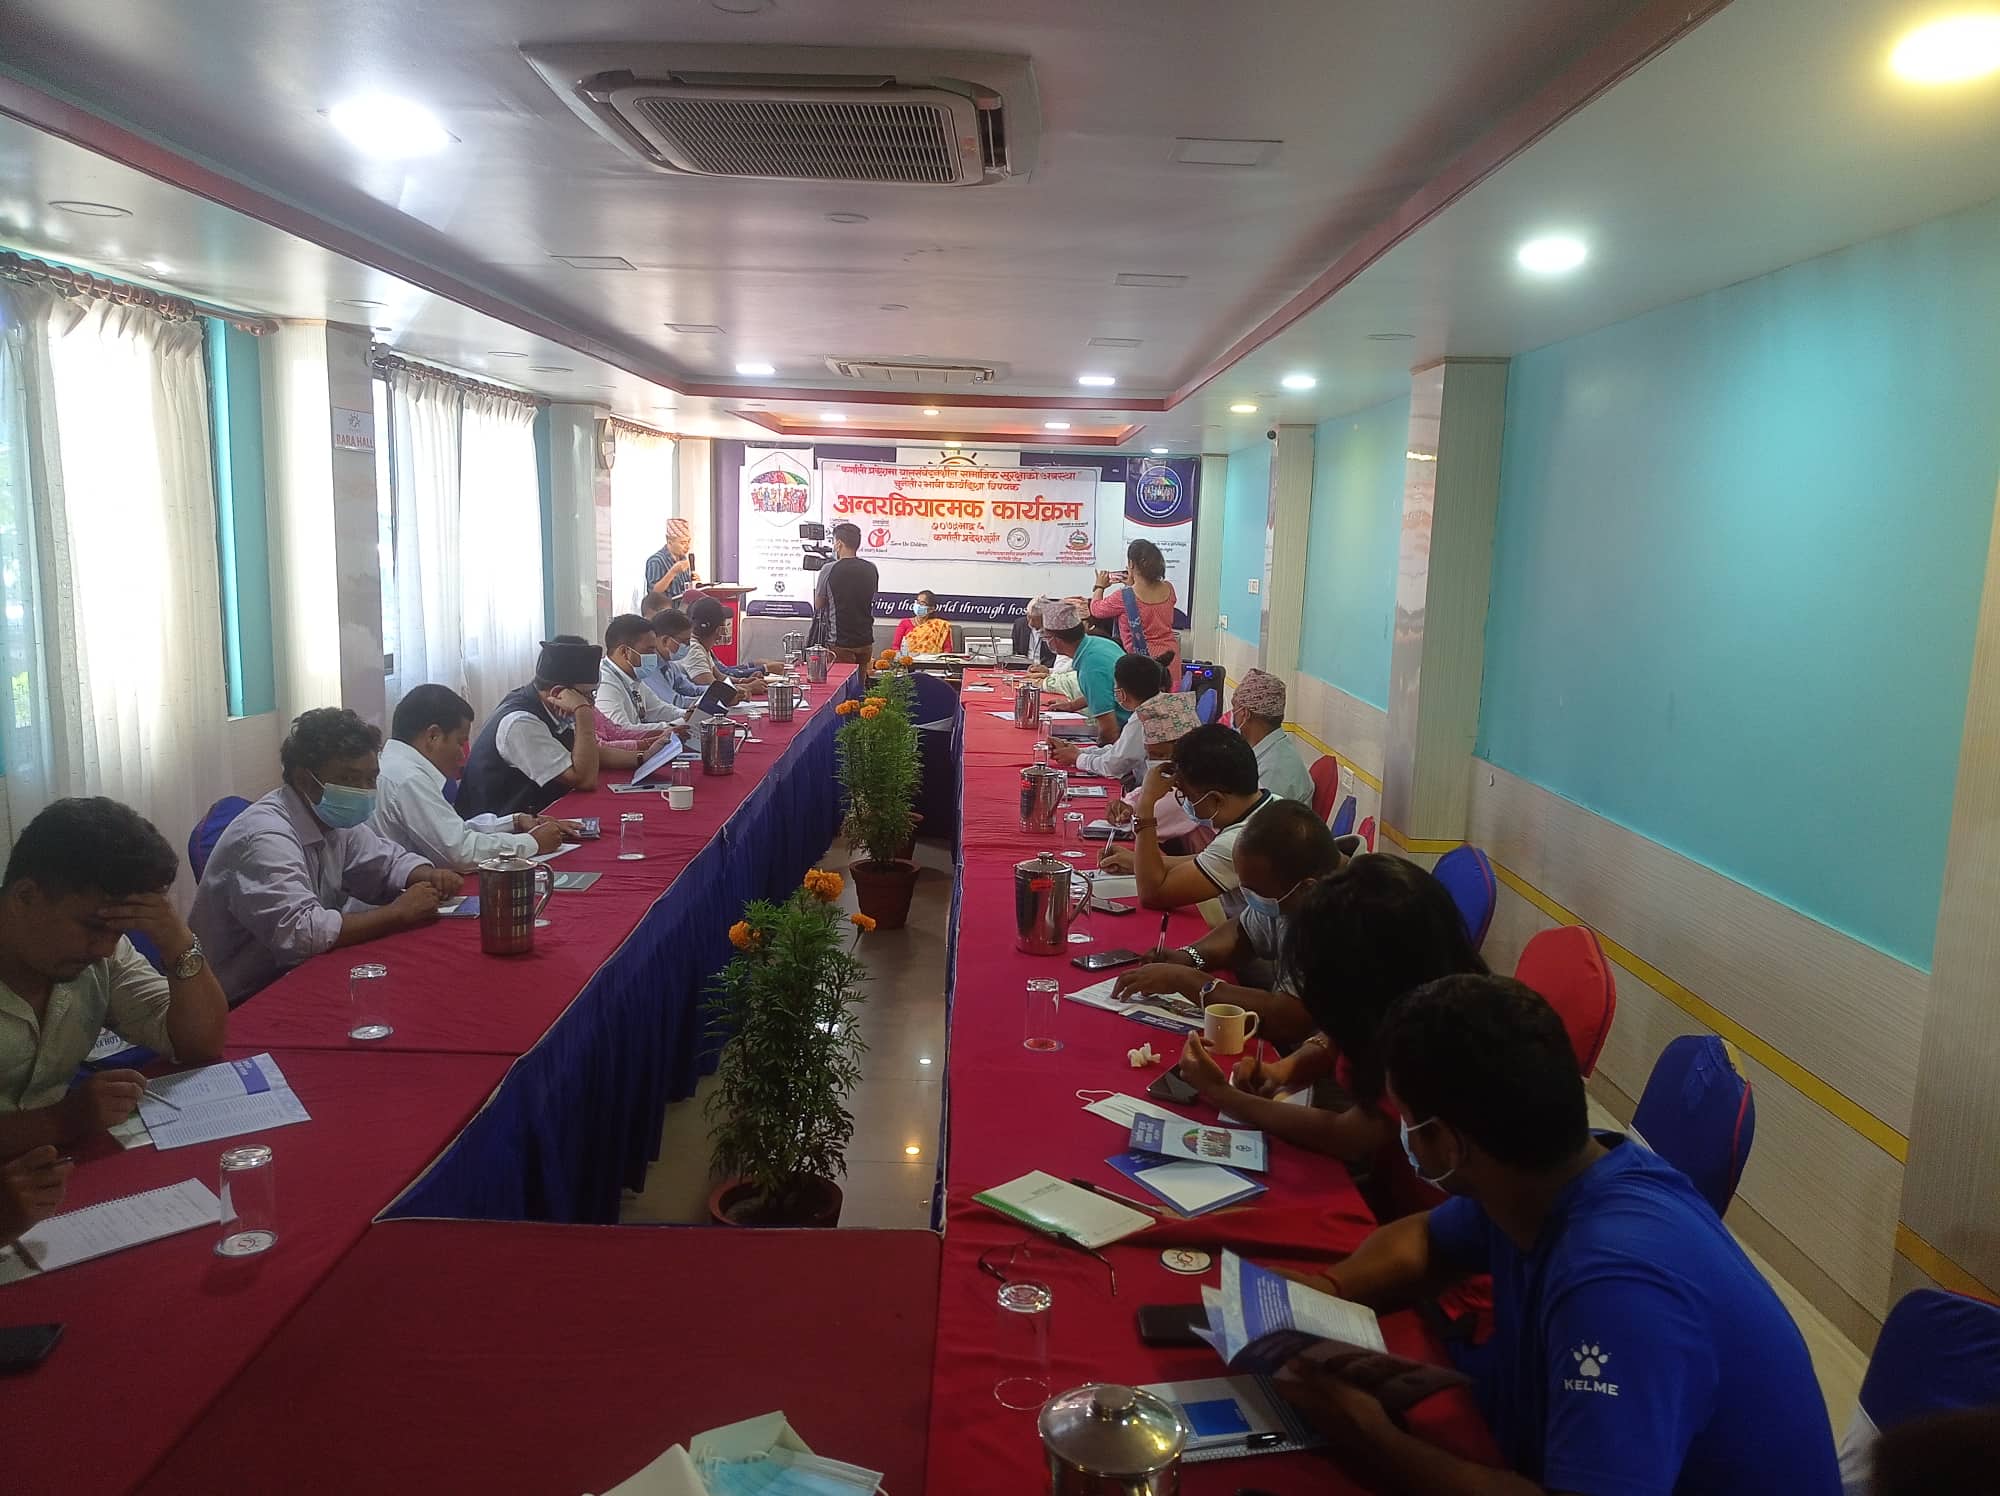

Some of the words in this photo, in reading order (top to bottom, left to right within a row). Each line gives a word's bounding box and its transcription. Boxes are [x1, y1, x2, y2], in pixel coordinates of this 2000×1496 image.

[357, 436, 374, 448] HALL
[833, 492, 985, 518] अन्तरक्रियात्मक
[991, 495, 1084, 522] कार्यक्रम
[960, 601, 1006, 618] through
[1008, 603, 1029, 616] hos
[1564, 1378, 1619, 1396] KELME
